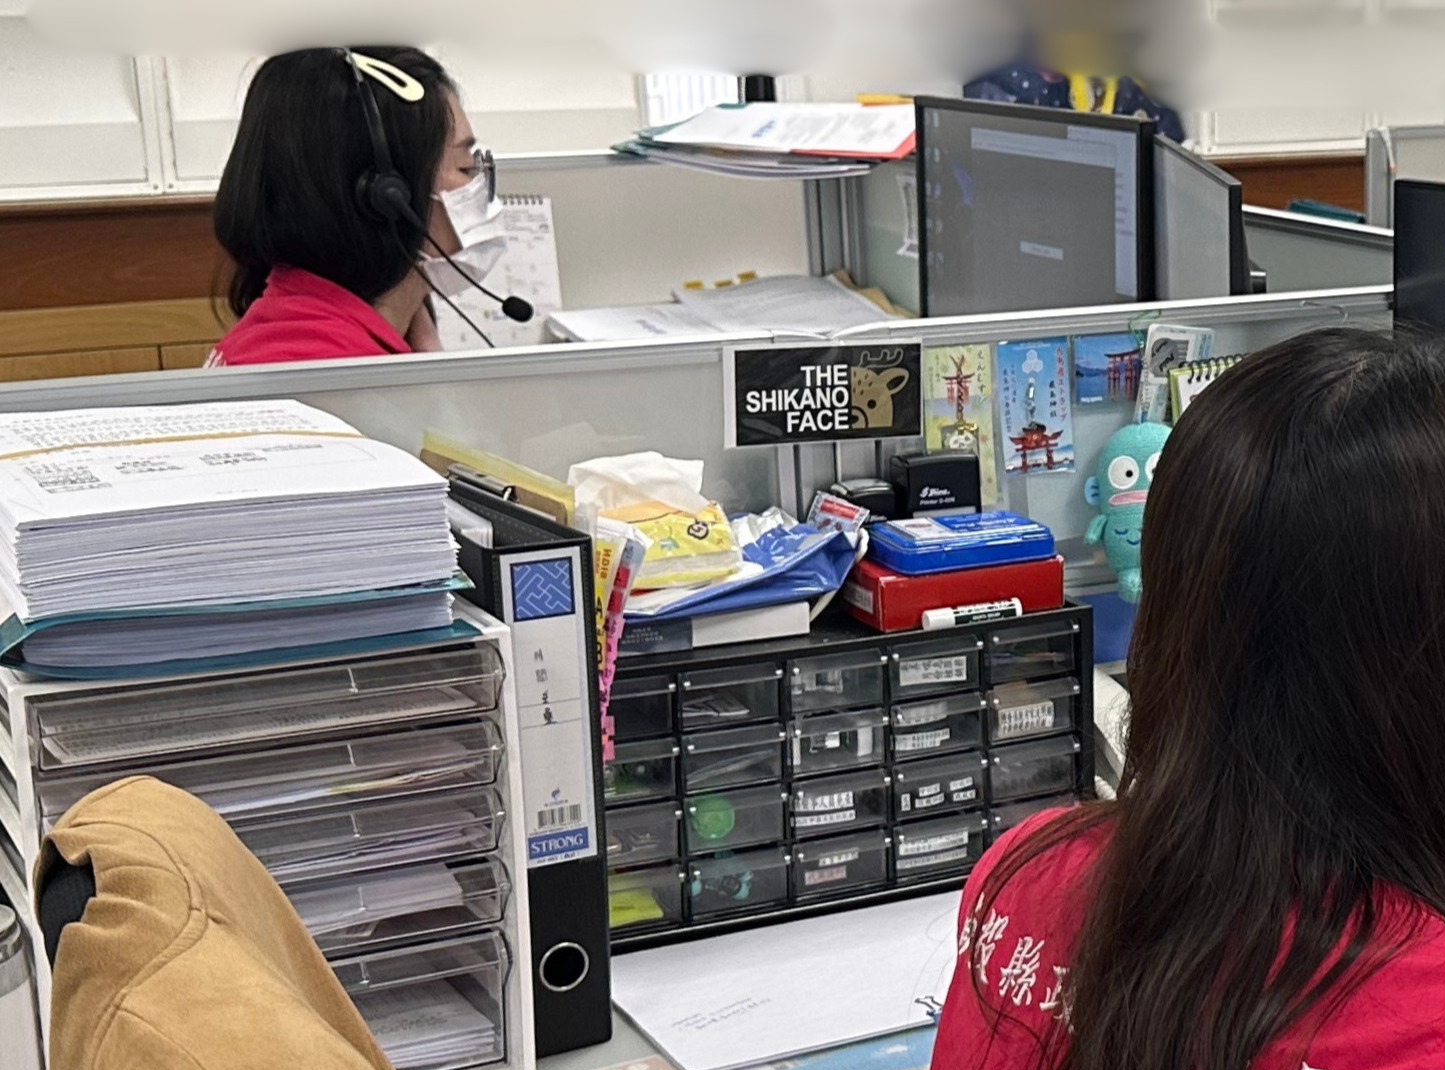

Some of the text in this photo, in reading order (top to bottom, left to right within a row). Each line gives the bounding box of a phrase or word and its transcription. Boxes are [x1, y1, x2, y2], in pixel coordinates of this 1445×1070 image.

[800, 364, 848, 387] THE
[746, 386, 849, 413] SHIKANO
[787, 408, 849, 433] FACE
[531, 832, 584, 855] STRONG
